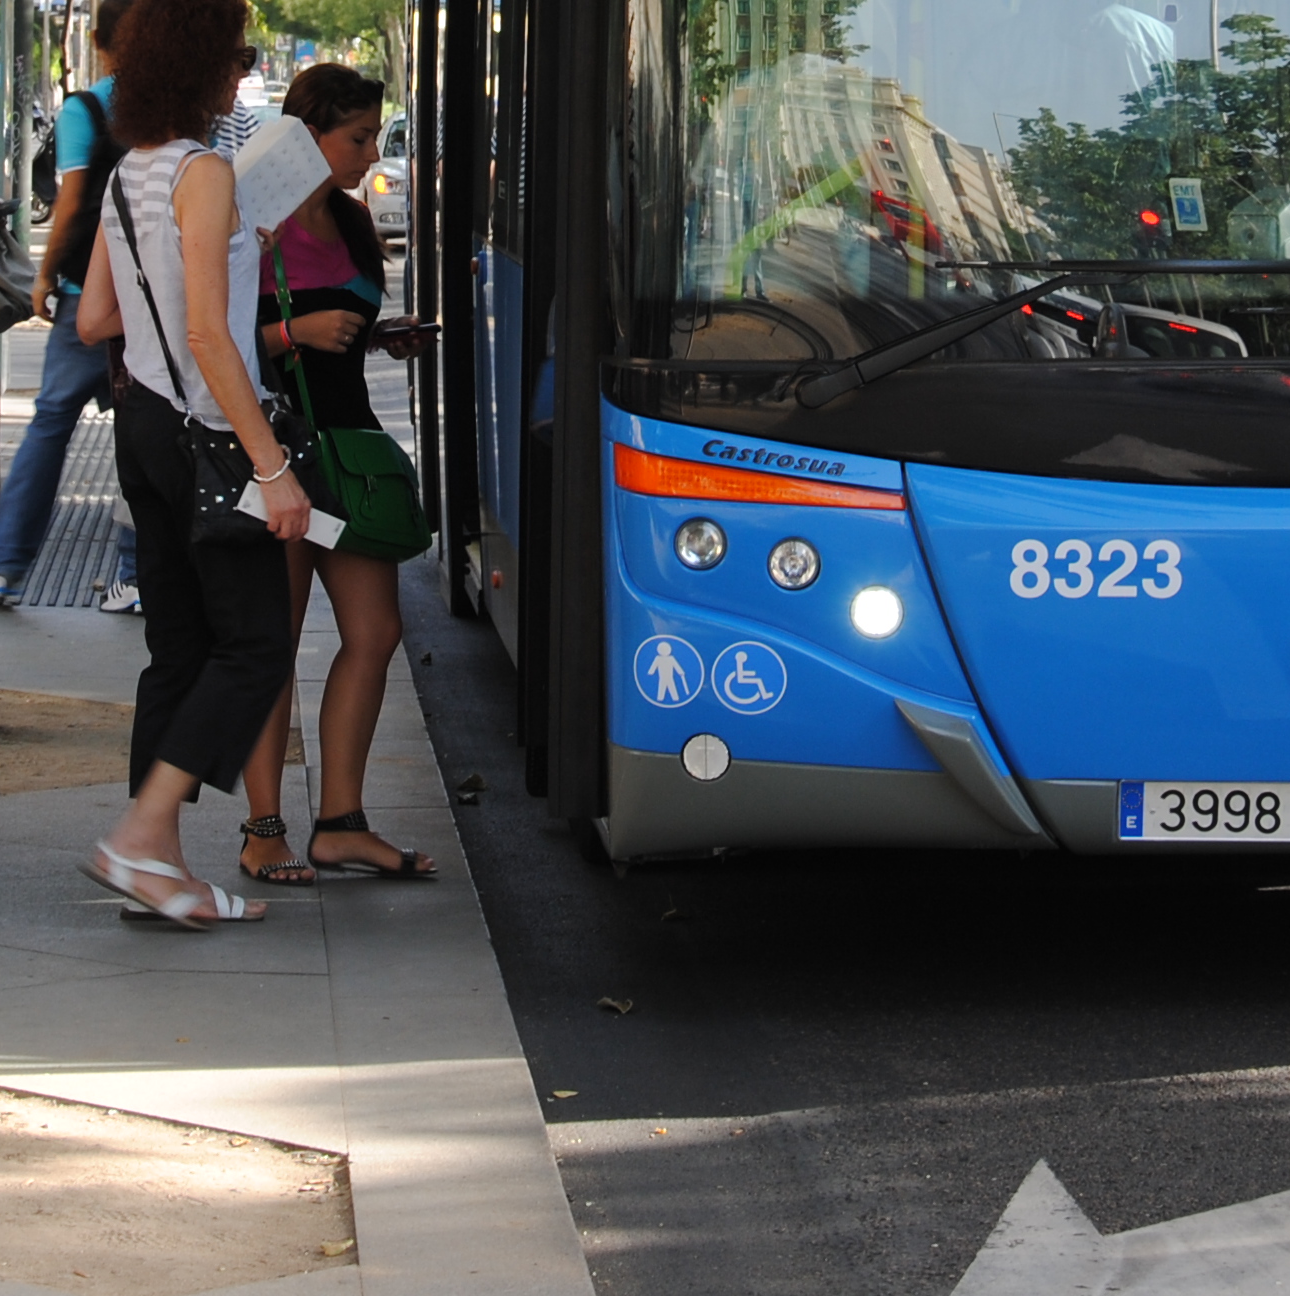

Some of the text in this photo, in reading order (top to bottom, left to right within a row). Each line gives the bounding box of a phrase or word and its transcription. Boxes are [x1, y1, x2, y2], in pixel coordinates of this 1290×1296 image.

[702, 439, 846, 476] Castrosua
[1010, 540, 1183, 598] 8323
[1126, 815, 1138, 829] E
[1159, 789, 1282, 834] 3998
